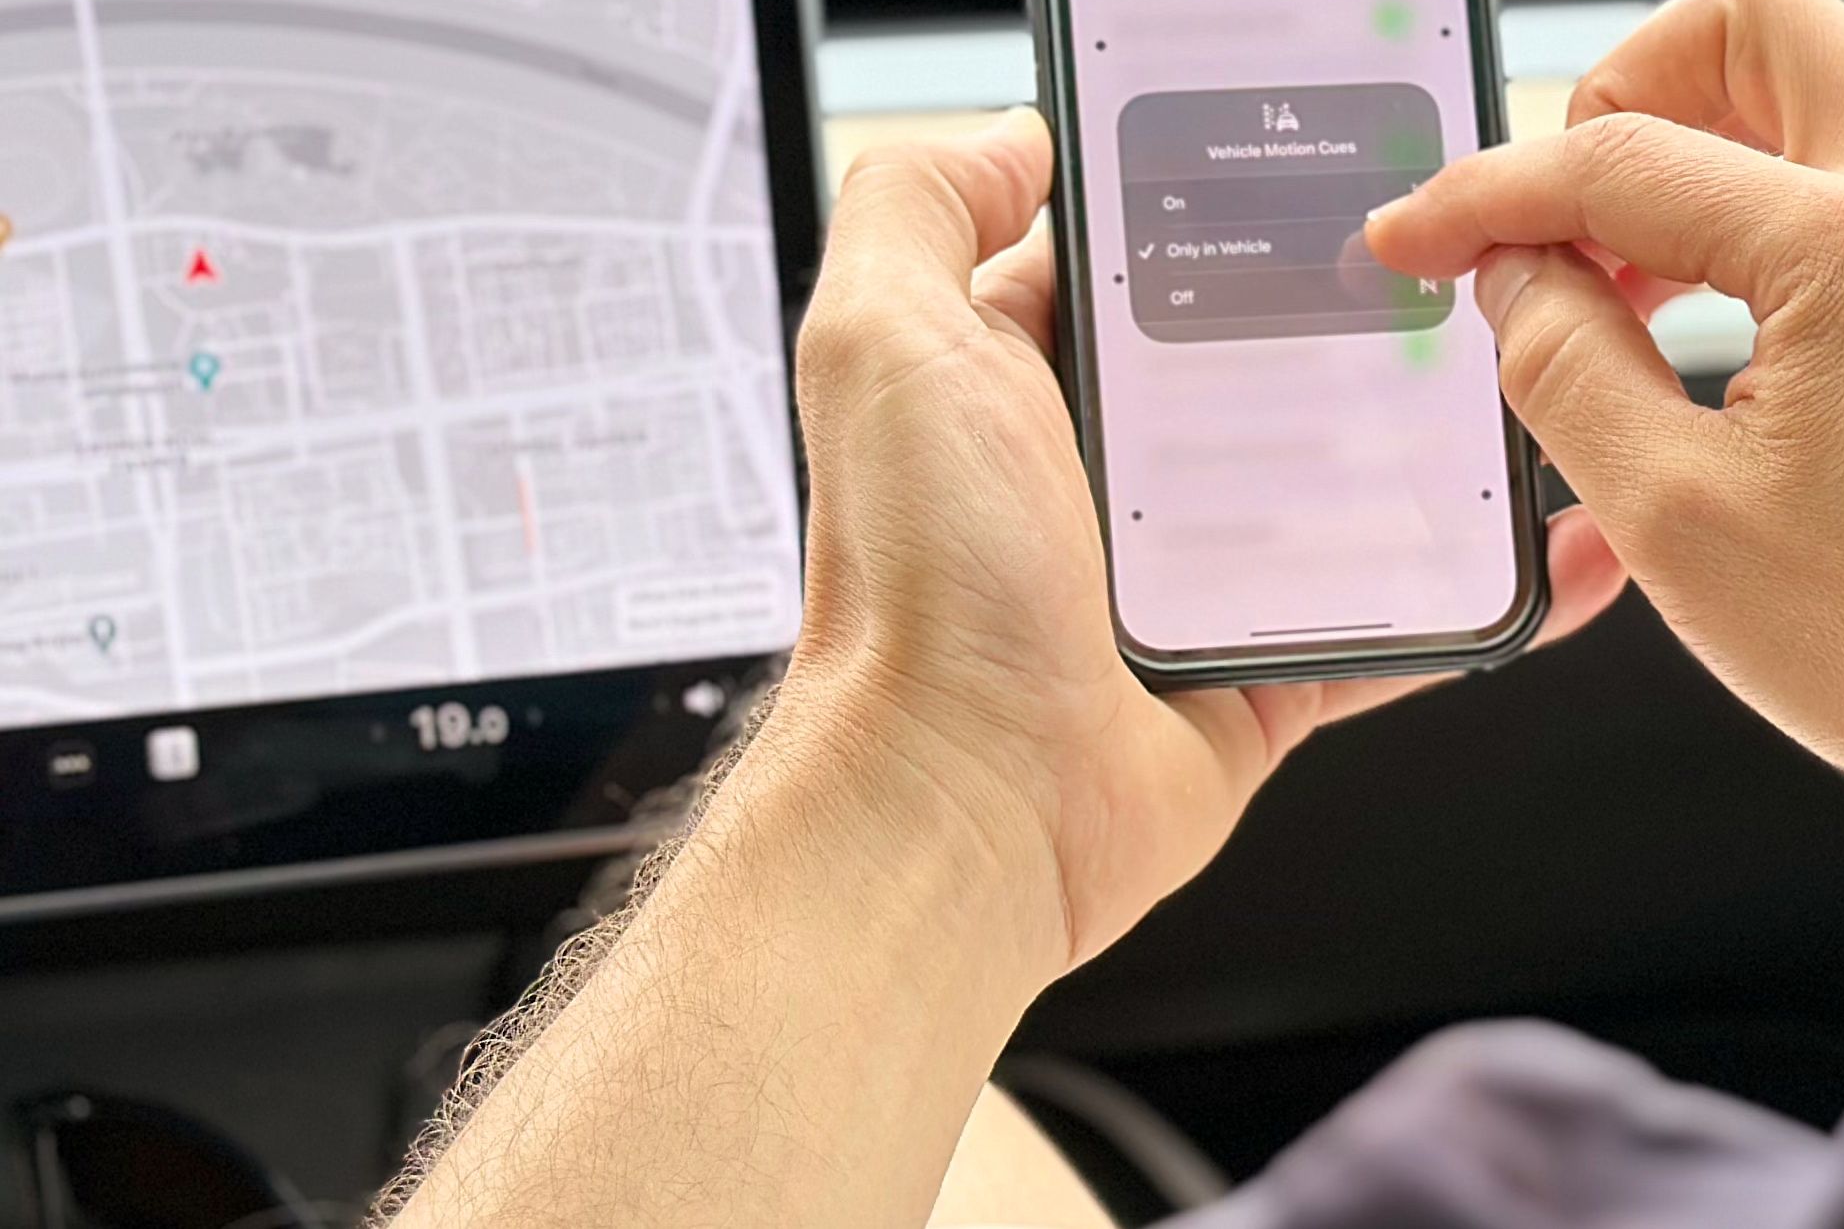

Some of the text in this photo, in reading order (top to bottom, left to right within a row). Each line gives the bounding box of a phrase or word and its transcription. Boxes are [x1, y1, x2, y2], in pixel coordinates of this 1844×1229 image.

[1206, 139, 1357, 160] Vehicle Motion Cues
[1162, 195, 1186, 211] On
[1166, 238, 1272, 260] Only in Vehicle
[1169, 289, 1195, 306] Off
[409, 701, 509, 751] 19.0
